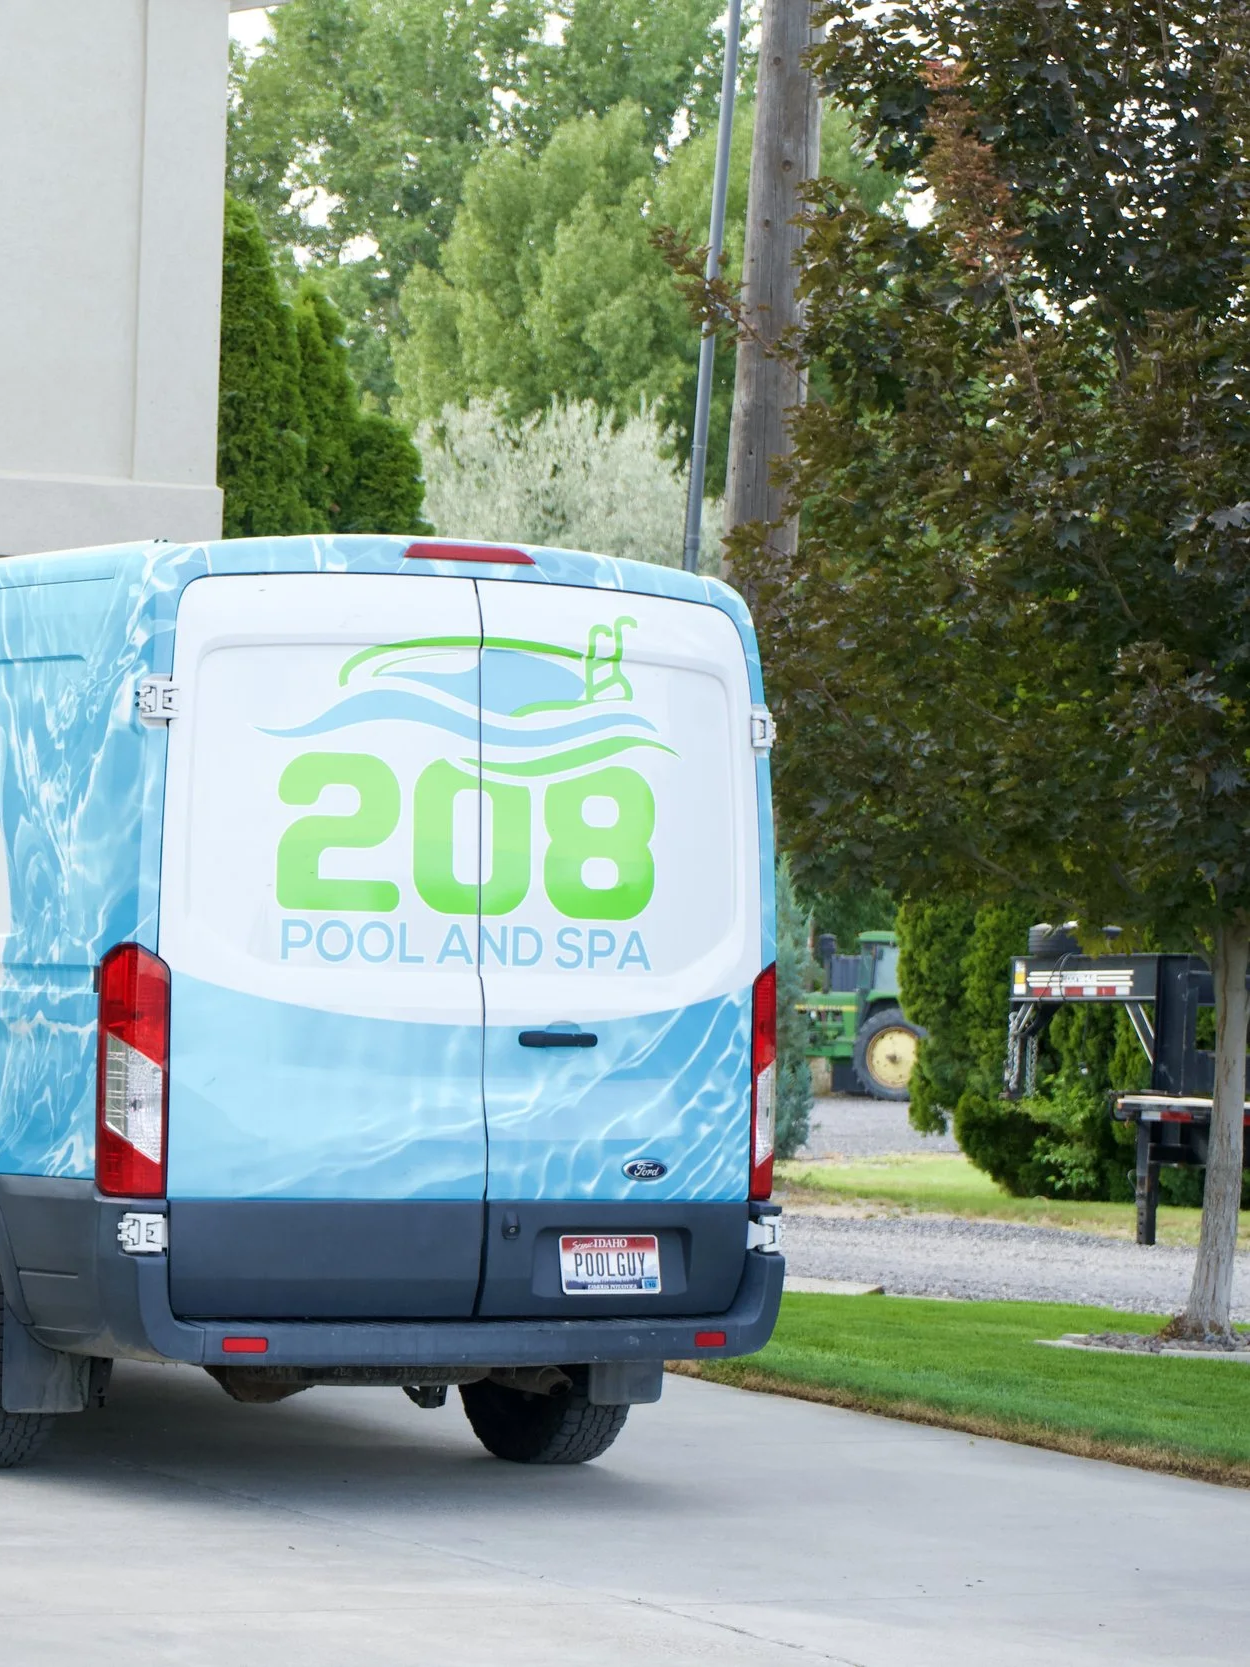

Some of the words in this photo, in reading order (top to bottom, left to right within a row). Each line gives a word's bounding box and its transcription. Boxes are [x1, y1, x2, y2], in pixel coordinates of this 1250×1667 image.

[276, 752, 656, 921] 208
[280, 918, 425, 964] POOL
[436, 923, 544, 968] AND
[554, 927, 652, 972] SPA
[634, 1163, 660, 1177] Ford
[594, 1238, 628, 1249] IDAHO
